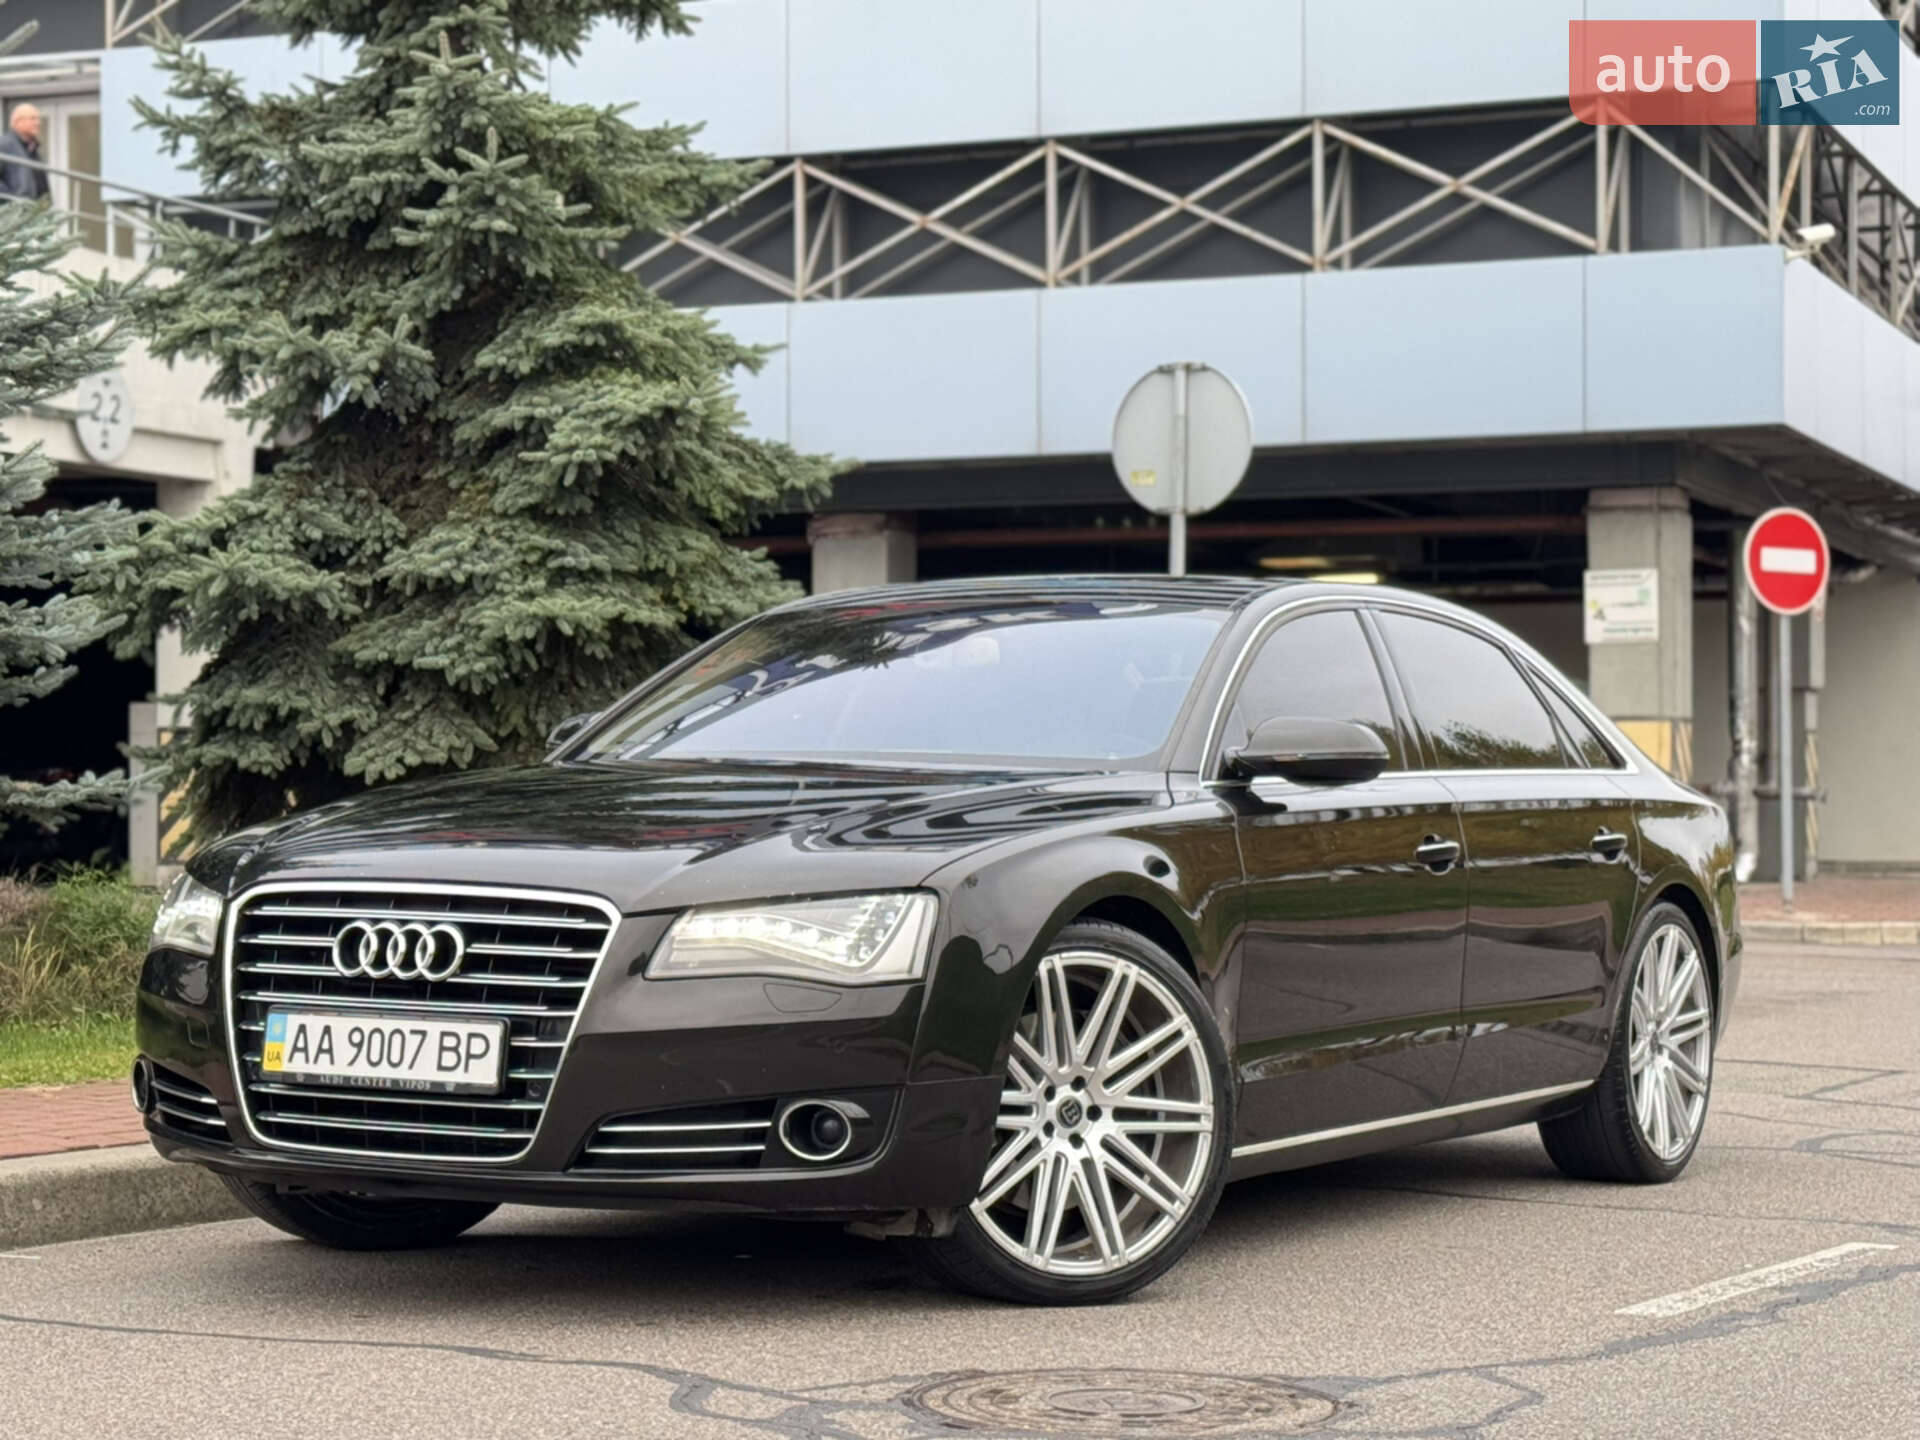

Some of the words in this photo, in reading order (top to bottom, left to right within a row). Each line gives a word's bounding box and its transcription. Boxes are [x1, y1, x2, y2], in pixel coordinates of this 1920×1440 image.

[91, 391, 120, 424] 22
[267, 1052, 281, 1063] UA
[288, 1023, 335, 1066] AA
[347, 1026, 427, 1071] 9007
[436, 1031, 490, 1074] BP
[319, 1074, 343, 1086] AUDI
[350, 1076, 392, 1089] CENTER
